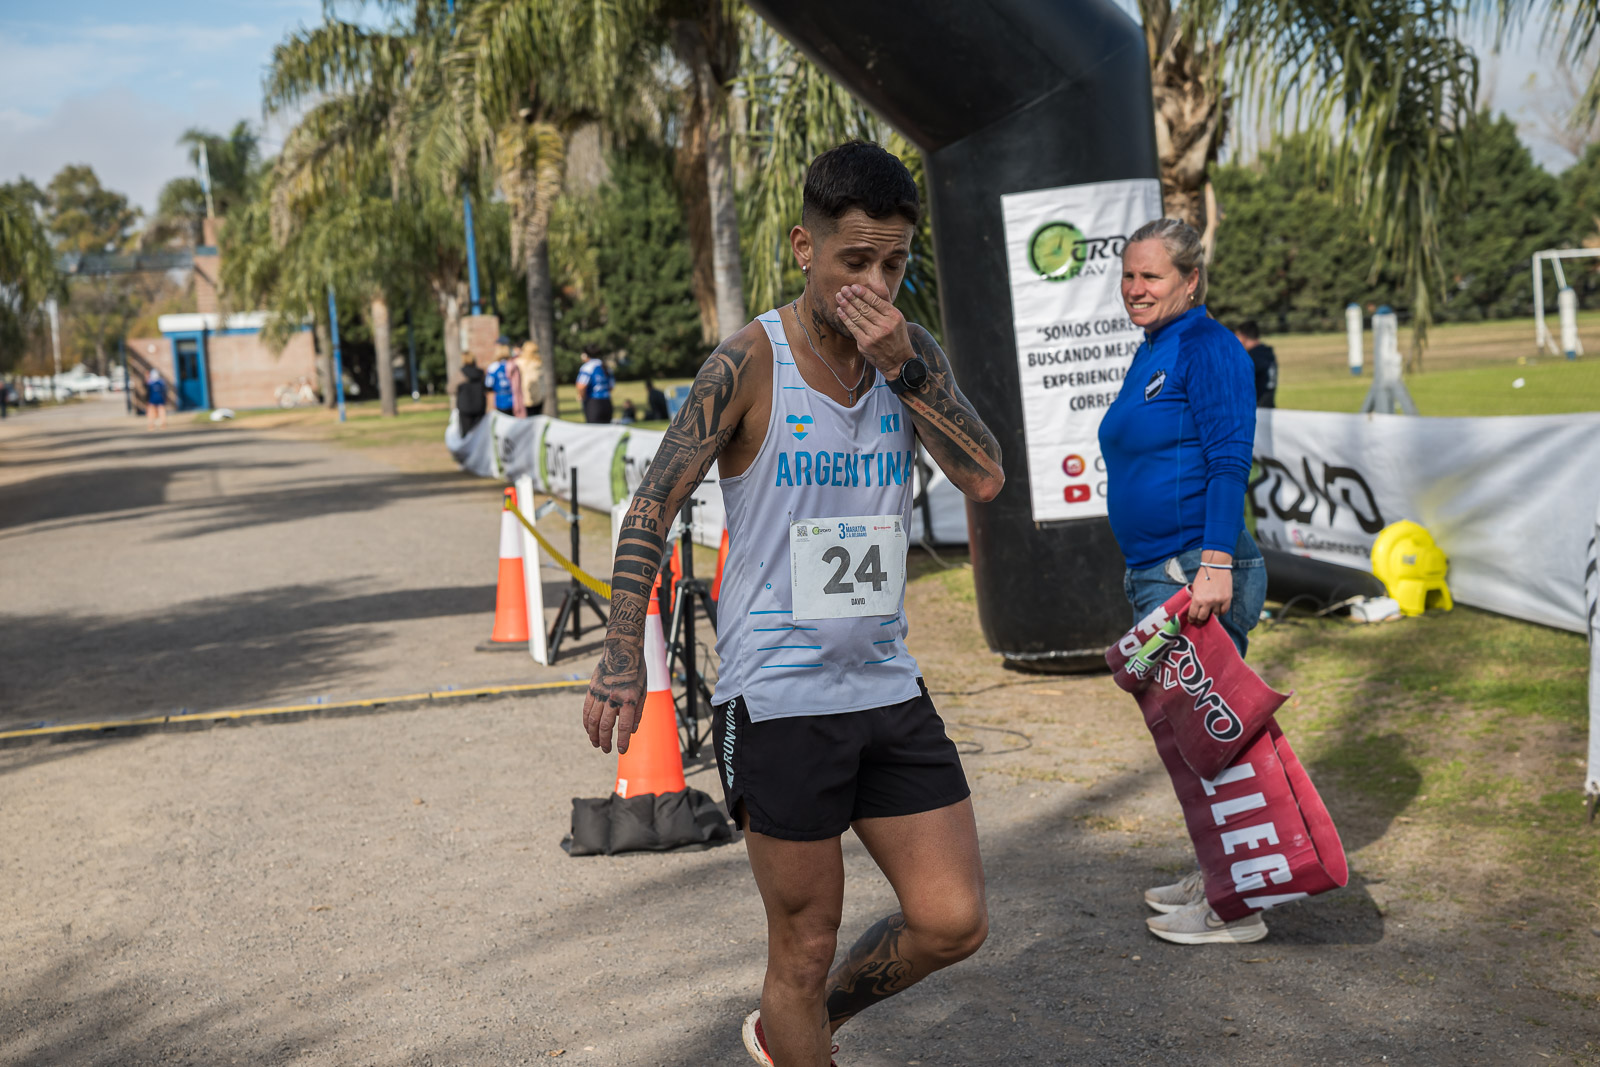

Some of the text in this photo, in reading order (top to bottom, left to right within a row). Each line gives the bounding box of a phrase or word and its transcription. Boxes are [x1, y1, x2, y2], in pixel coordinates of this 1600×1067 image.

[1094, 317, 1141, 335] CORRE
[1028, 340, 1143, 367] BUSCANDO MEJO
[1070, 391, 1118, 411] CORRE
[775, 450, 911, 487] ARGENTINA
[821, 544, 887, 595] 24
[851, 597, 866, 606] DAVID
[723, 699, 737, 765] RUNNING
